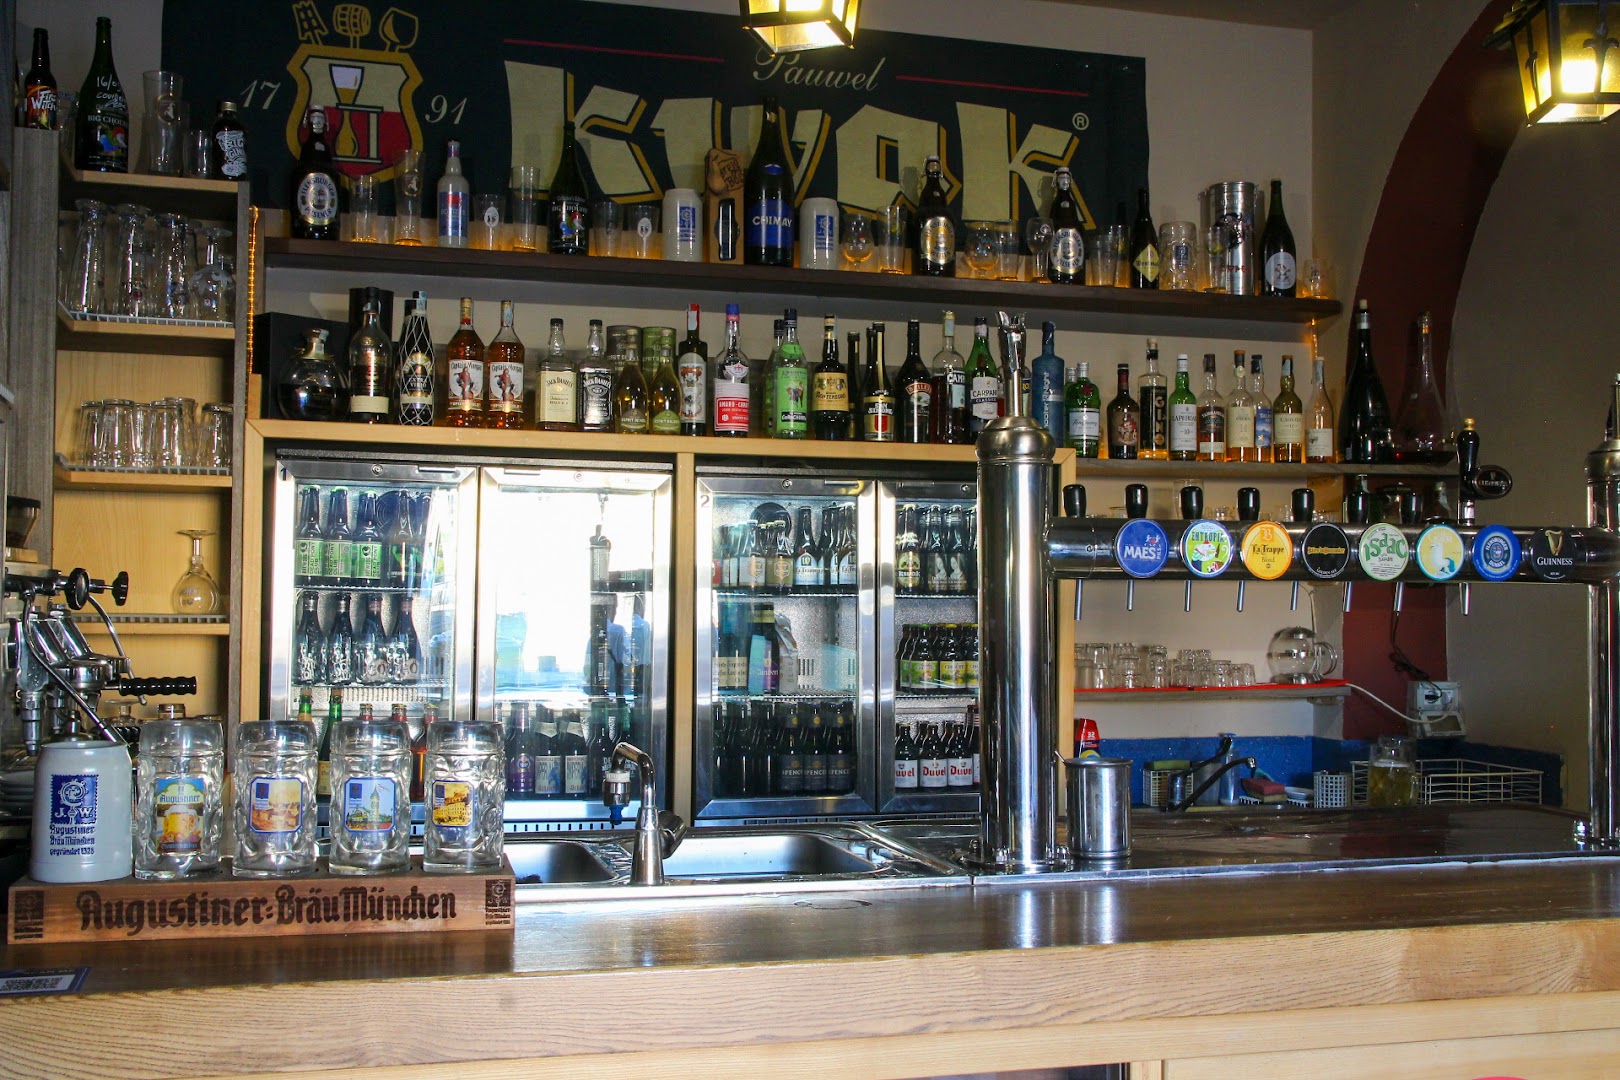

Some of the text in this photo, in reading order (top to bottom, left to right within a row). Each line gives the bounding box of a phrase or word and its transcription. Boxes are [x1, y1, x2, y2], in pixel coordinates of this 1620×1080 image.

[753, 50, 886, 93] Pauwel
[240, 80, 281, 109] 17
[425, 95, 469, 126] 91
[752, 215, 793, 228] CHIMAY
[1123, 545, 1156, 560] MAES
[1261, 544, 1285, 555] Trappe
[1536, 556, 1573, 566] GUINNESS
[159, 794, 201, 804] Augustiner
[49, 824, 96, 837] Augustiner
[64, 835, 96, 846] München
[340, 884, 457, 923] München
